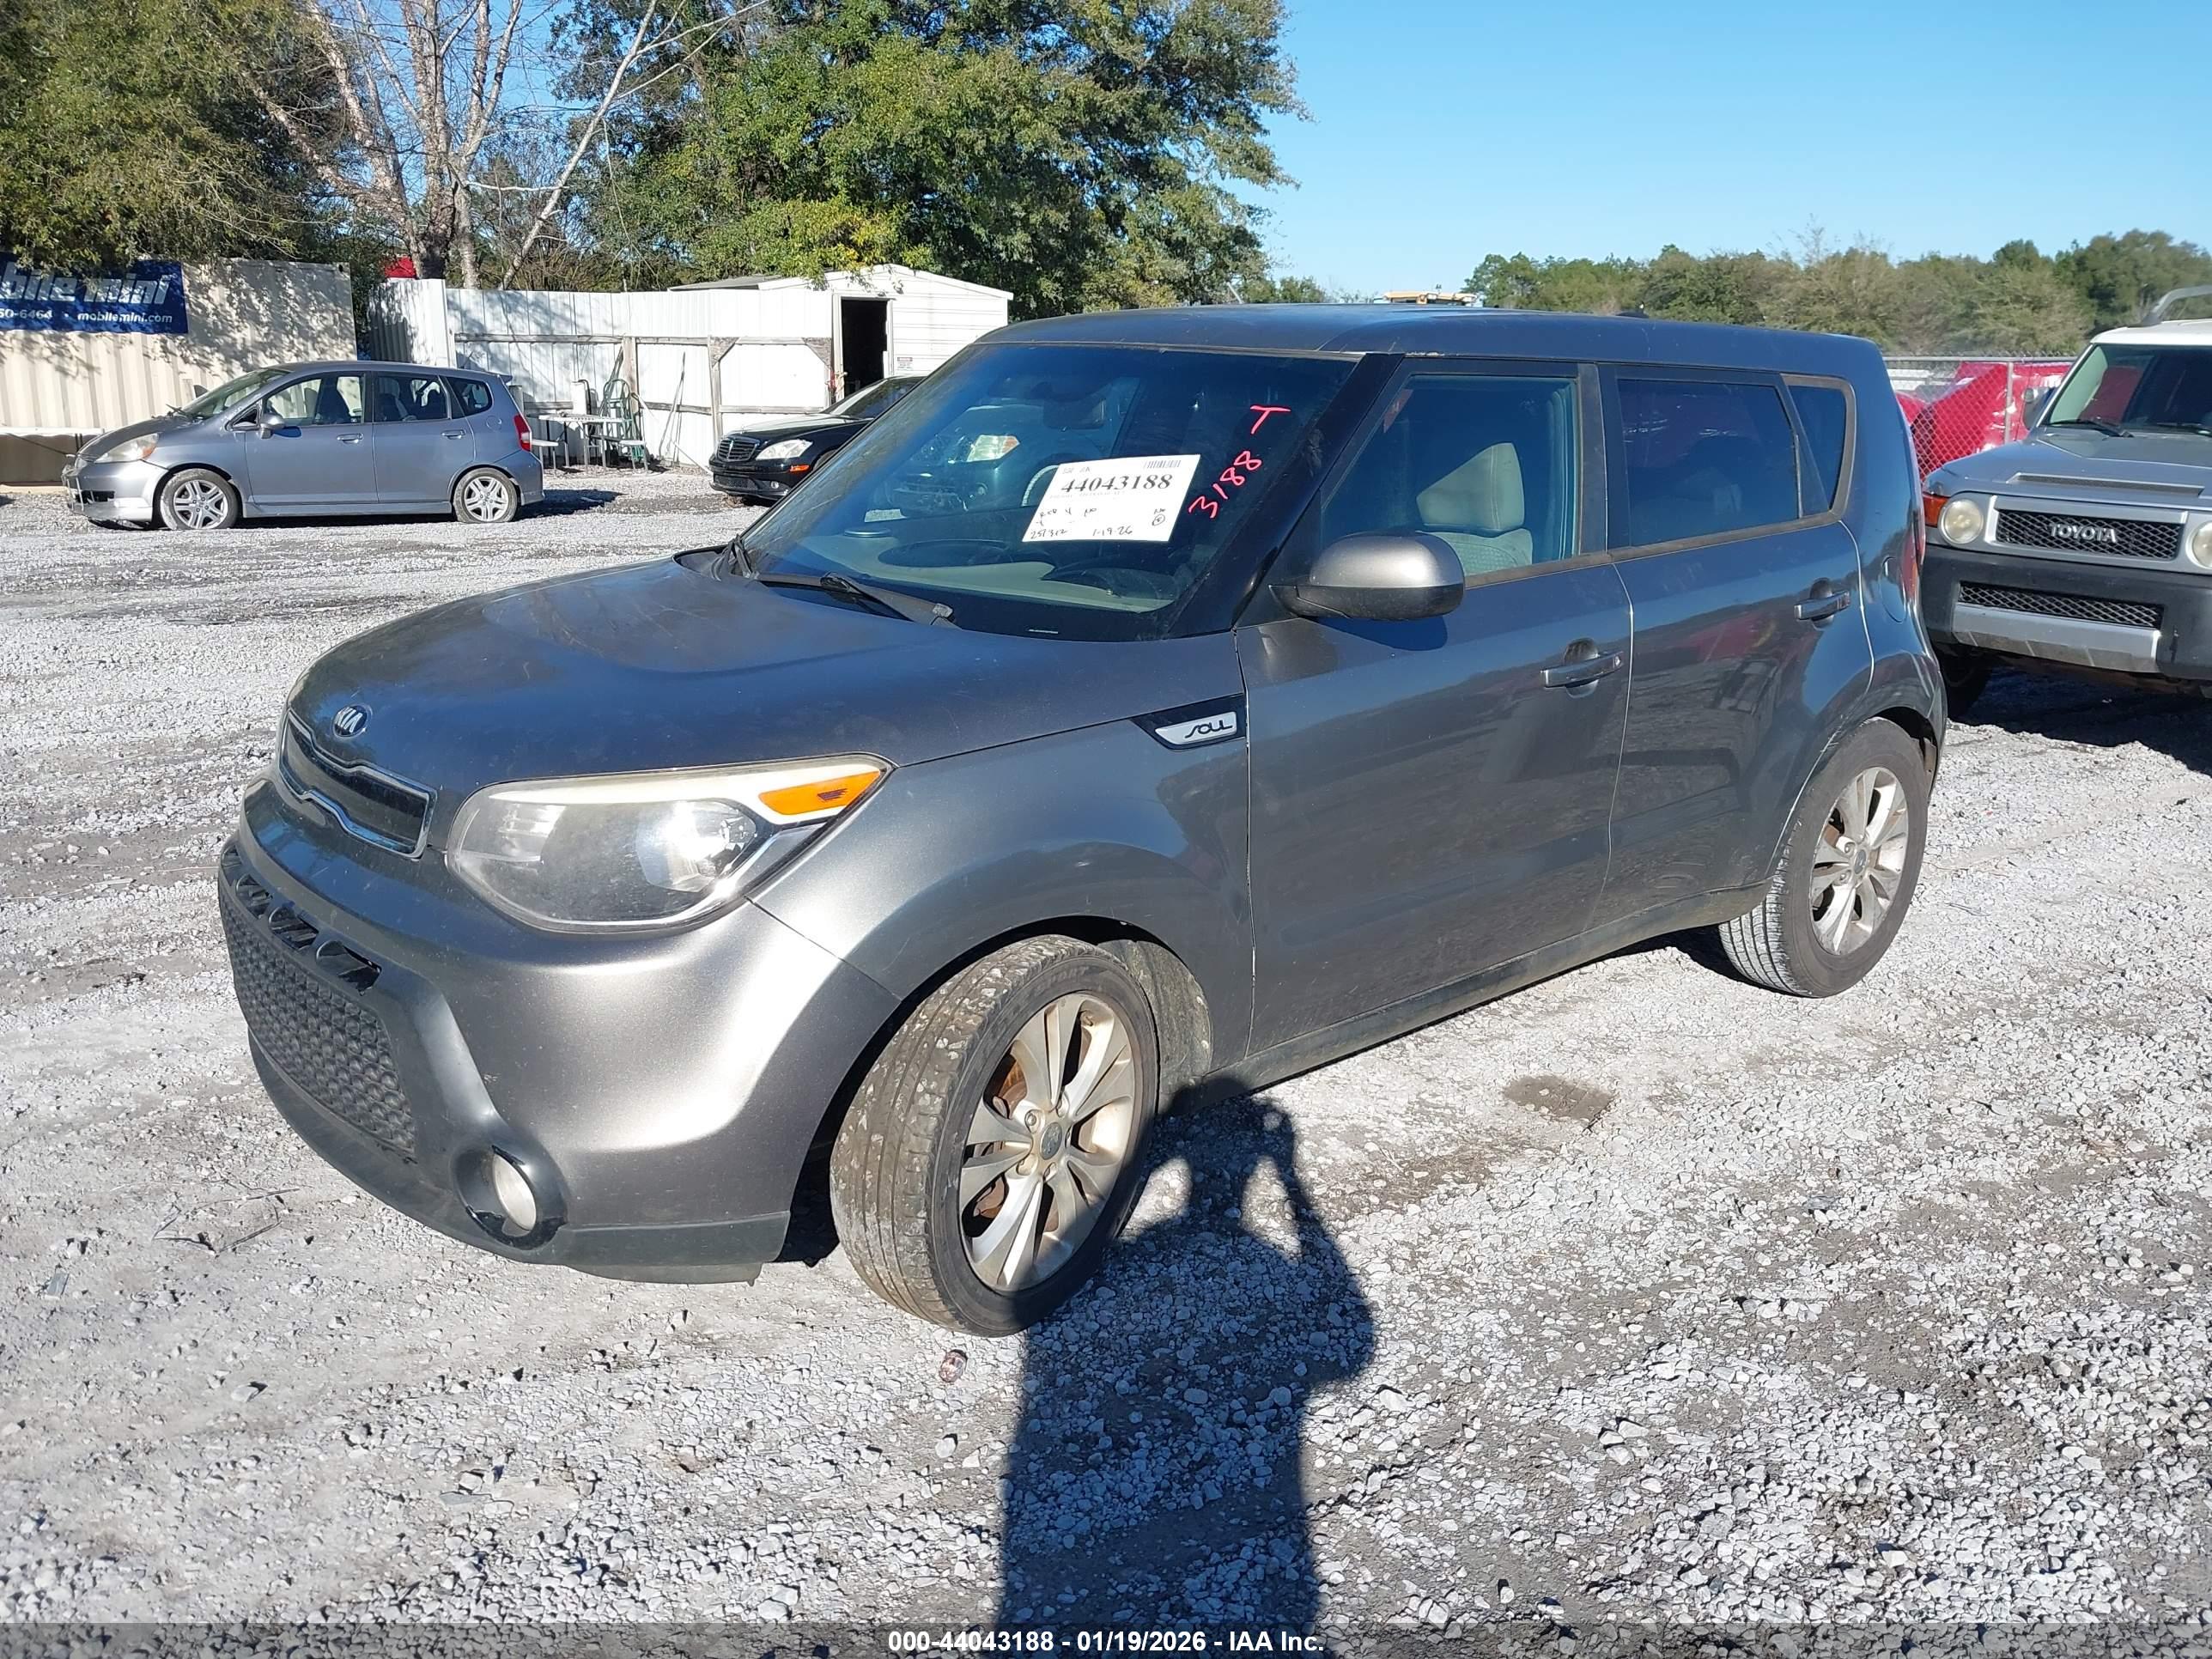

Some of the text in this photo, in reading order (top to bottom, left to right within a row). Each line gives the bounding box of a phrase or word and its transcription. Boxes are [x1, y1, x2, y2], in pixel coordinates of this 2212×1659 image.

[0, 261, 172, 304] bile mini
[77, 312, 173, 323] mobilemini.com
[1249, 404, 1291, 434] T
[1061, 473, 1173, 494] 44043188
[1188, 450, 1262, 519] 3188
[2050, 523, 2118, 544] TOYOTA
[334, 707, 363, 733] KIA
[1184, 719, 1233, 738] SOUL
